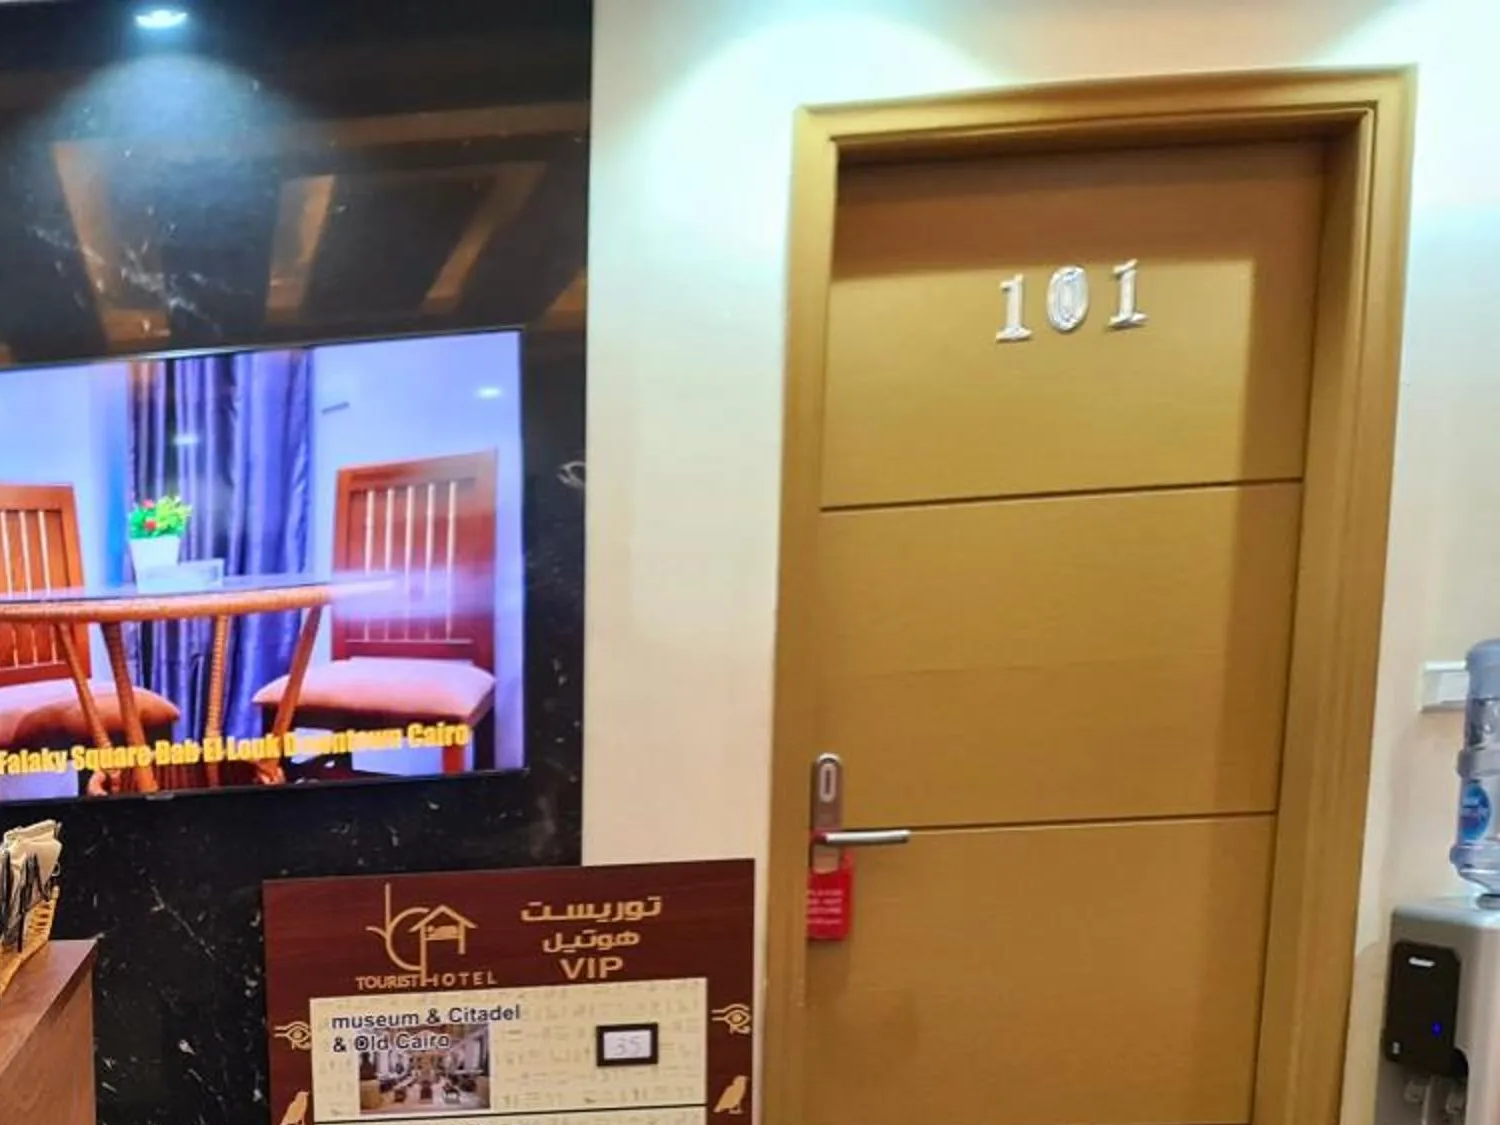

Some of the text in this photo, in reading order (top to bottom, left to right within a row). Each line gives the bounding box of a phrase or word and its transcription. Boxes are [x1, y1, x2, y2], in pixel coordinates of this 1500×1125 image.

[996, 258, 1148, 341] 101
[283, 728, 403, 757] Dntn
[406, 721, 469, 749] Cairo
[521, 896, 661, 923] توريست
[542, 929, 640, 953] هوتيل
[356, 970, 499, 991] TOURIST HOTEL
[559, 956, 623, 980] VIP
[331, 1004, 521, 1030] museum & Citadel
[332, 1033, 450, 1052] & Old Cairo
